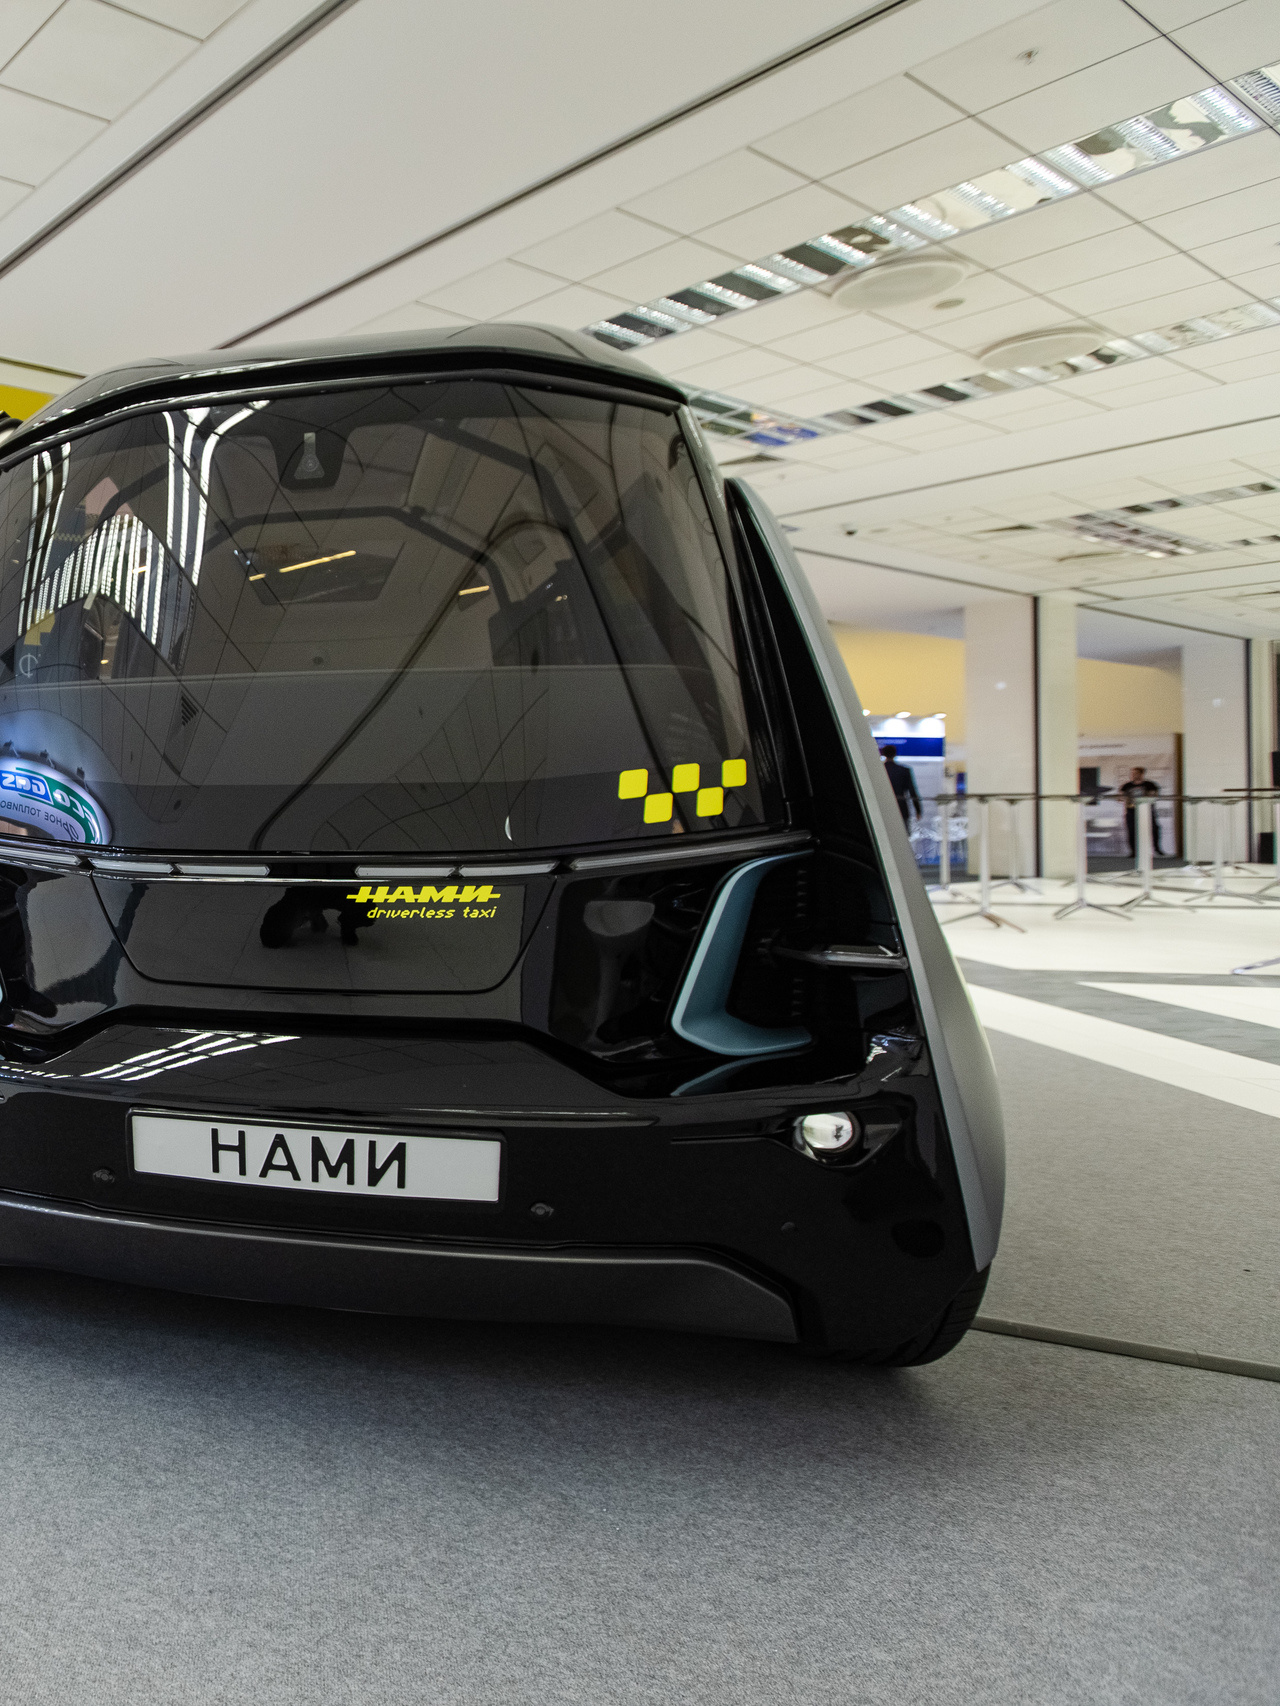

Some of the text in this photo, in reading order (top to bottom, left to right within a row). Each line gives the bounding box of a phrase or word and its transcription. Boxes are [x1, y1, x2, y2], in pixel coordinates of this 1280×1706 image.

[346, 885, 501, 903] НАМИ
[367, 906, 497, 918] driverless taxi
[210, 1127, 408, 1190] НАМИ
